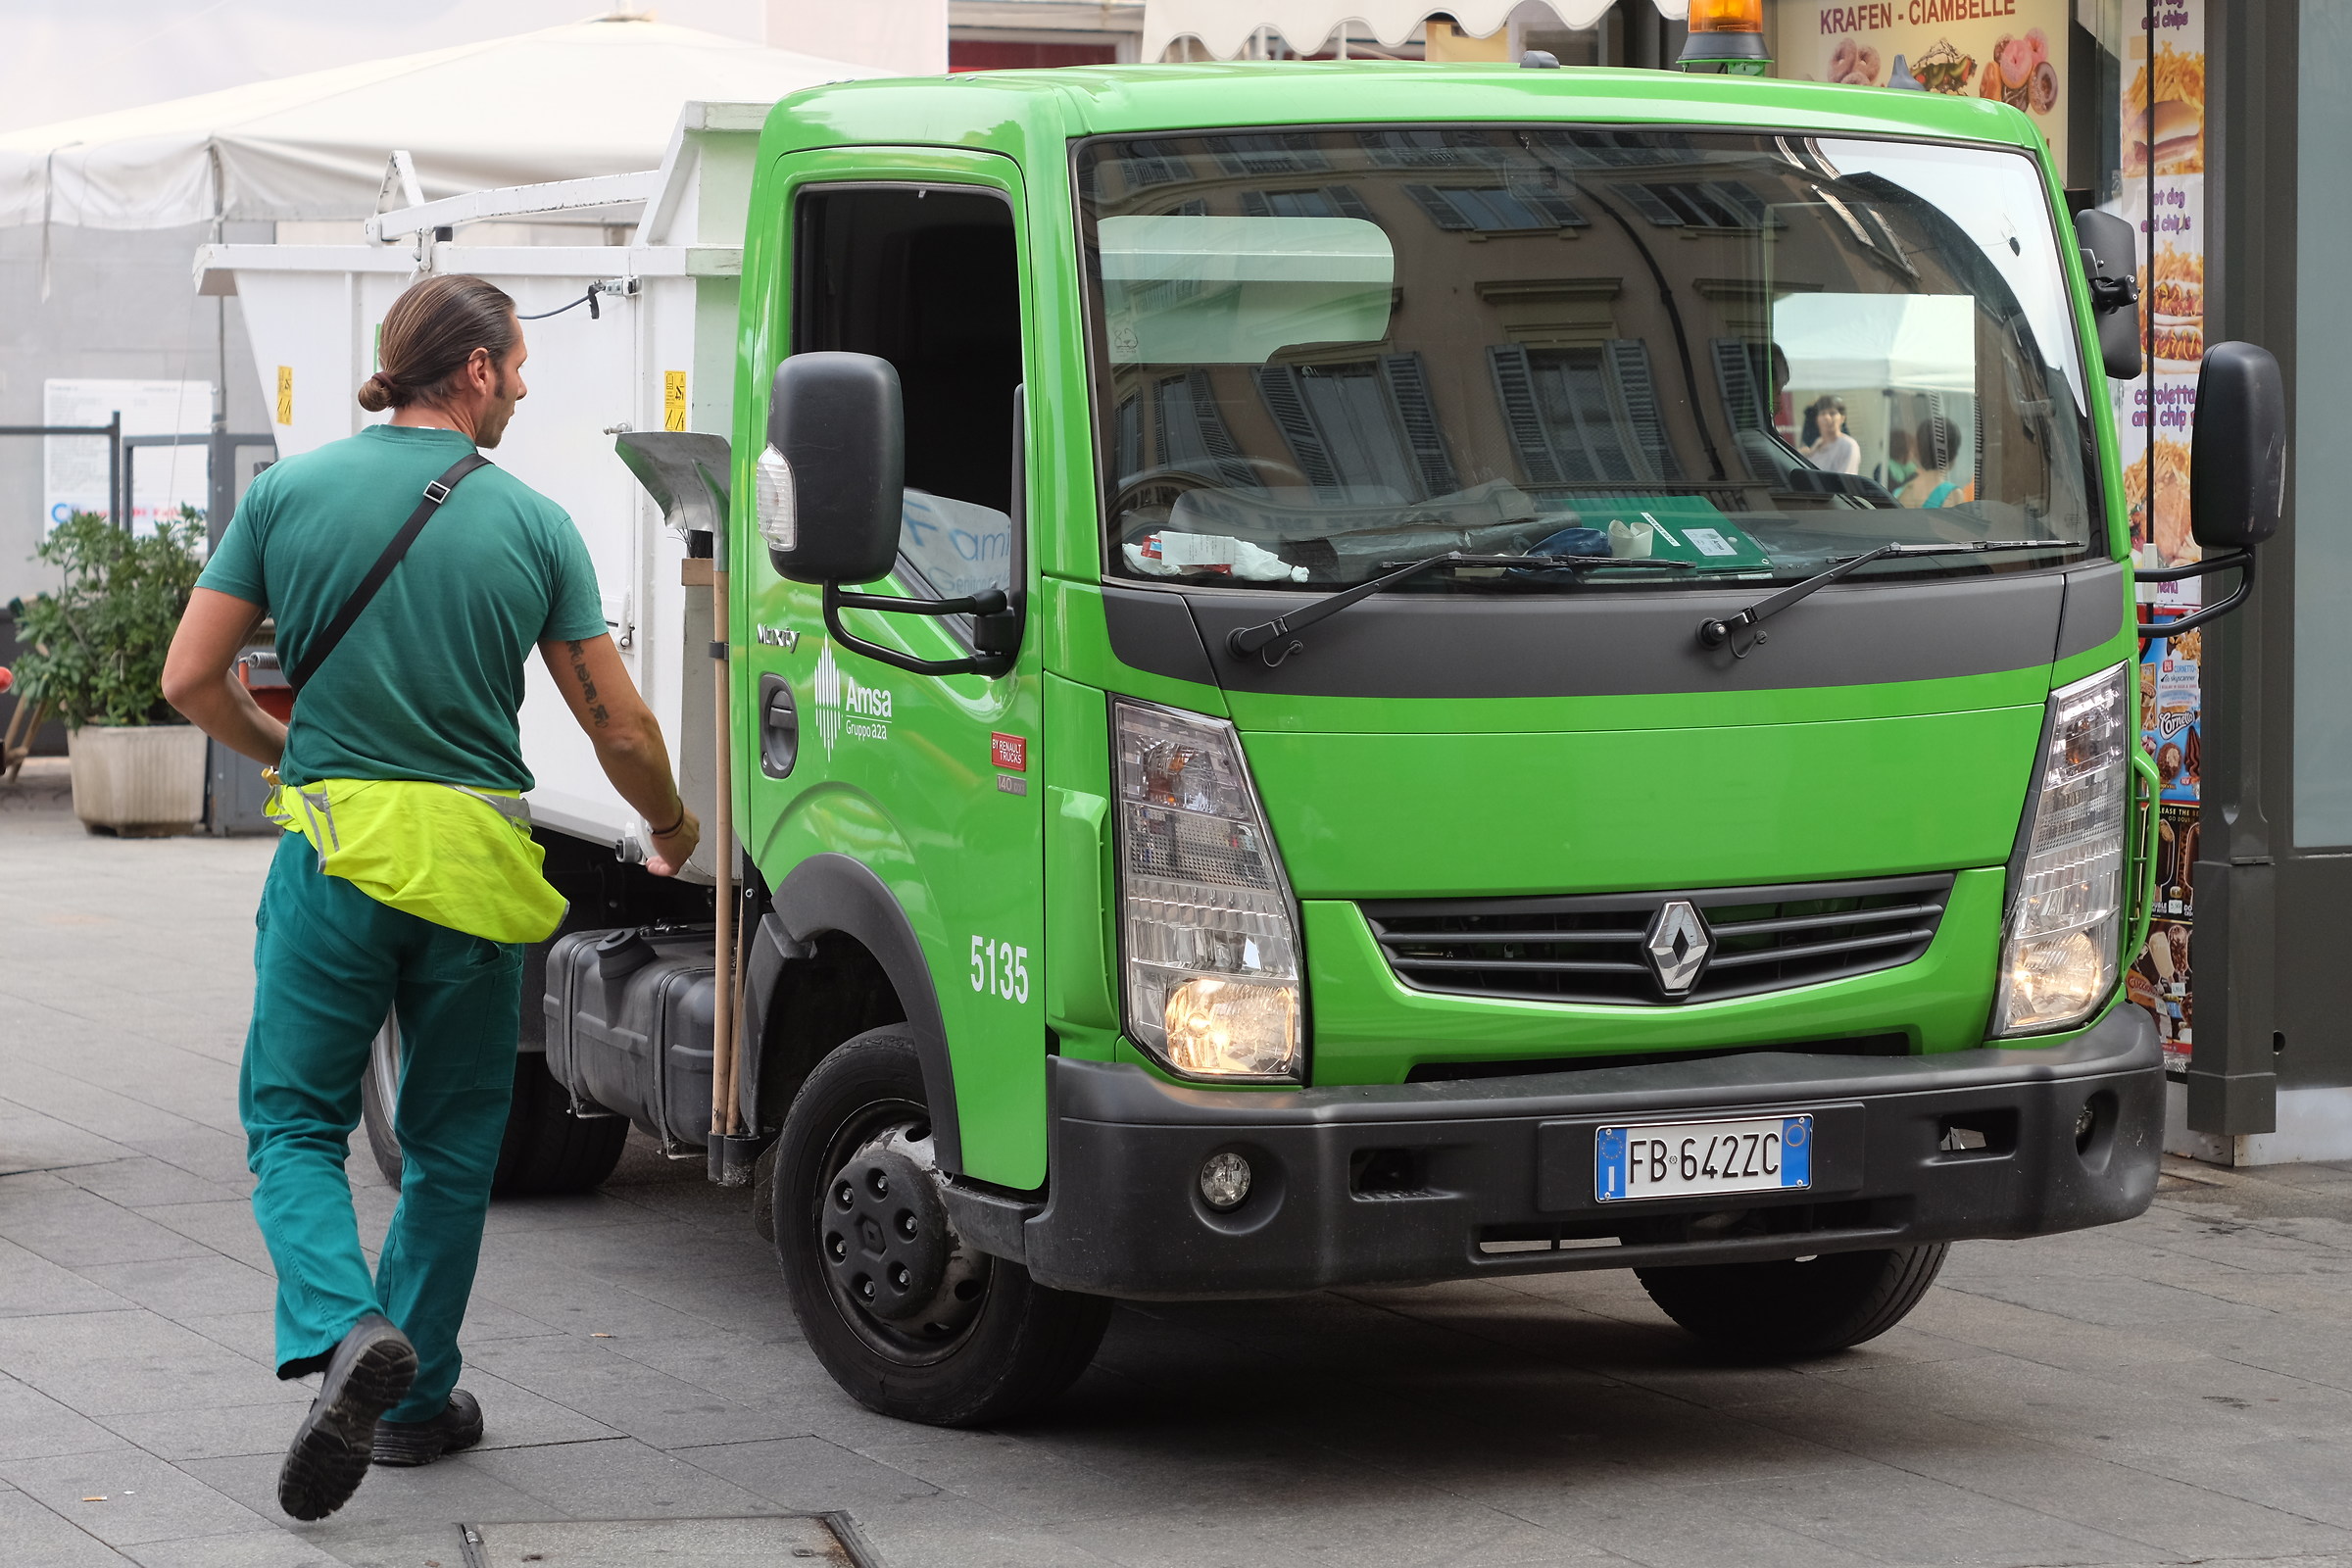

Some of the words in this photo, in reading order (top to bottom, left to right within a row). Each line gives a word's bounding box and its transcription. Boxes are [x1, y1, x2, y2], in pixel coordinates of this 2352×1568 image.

[1820, 2, 1892, 35] KRAFEN
[1908, 0, 2016, 25] CIAMBELLE
[2141, 11, 2160, 30] ad
[2153, 189, 2165, 206] ot
[2167, 186, 2185, 209] dog
[2140, 214, 2160, 233] ad
[2134, 382, 2196, 405] cooletta
[846, 676, 892, 717] Amsa
[846, 719, 871, 741] Gruppo
[2159, 711, 2194, 741] Cornetto
[992, 738, 1000, 750] BY
[1000, 740, 1022, 755] RENAULT
[1000, 750, 1022, 764] TRUCKS
[998, 775, 1012, 792] 140
[970, 934, 1029, 1004] 5135
